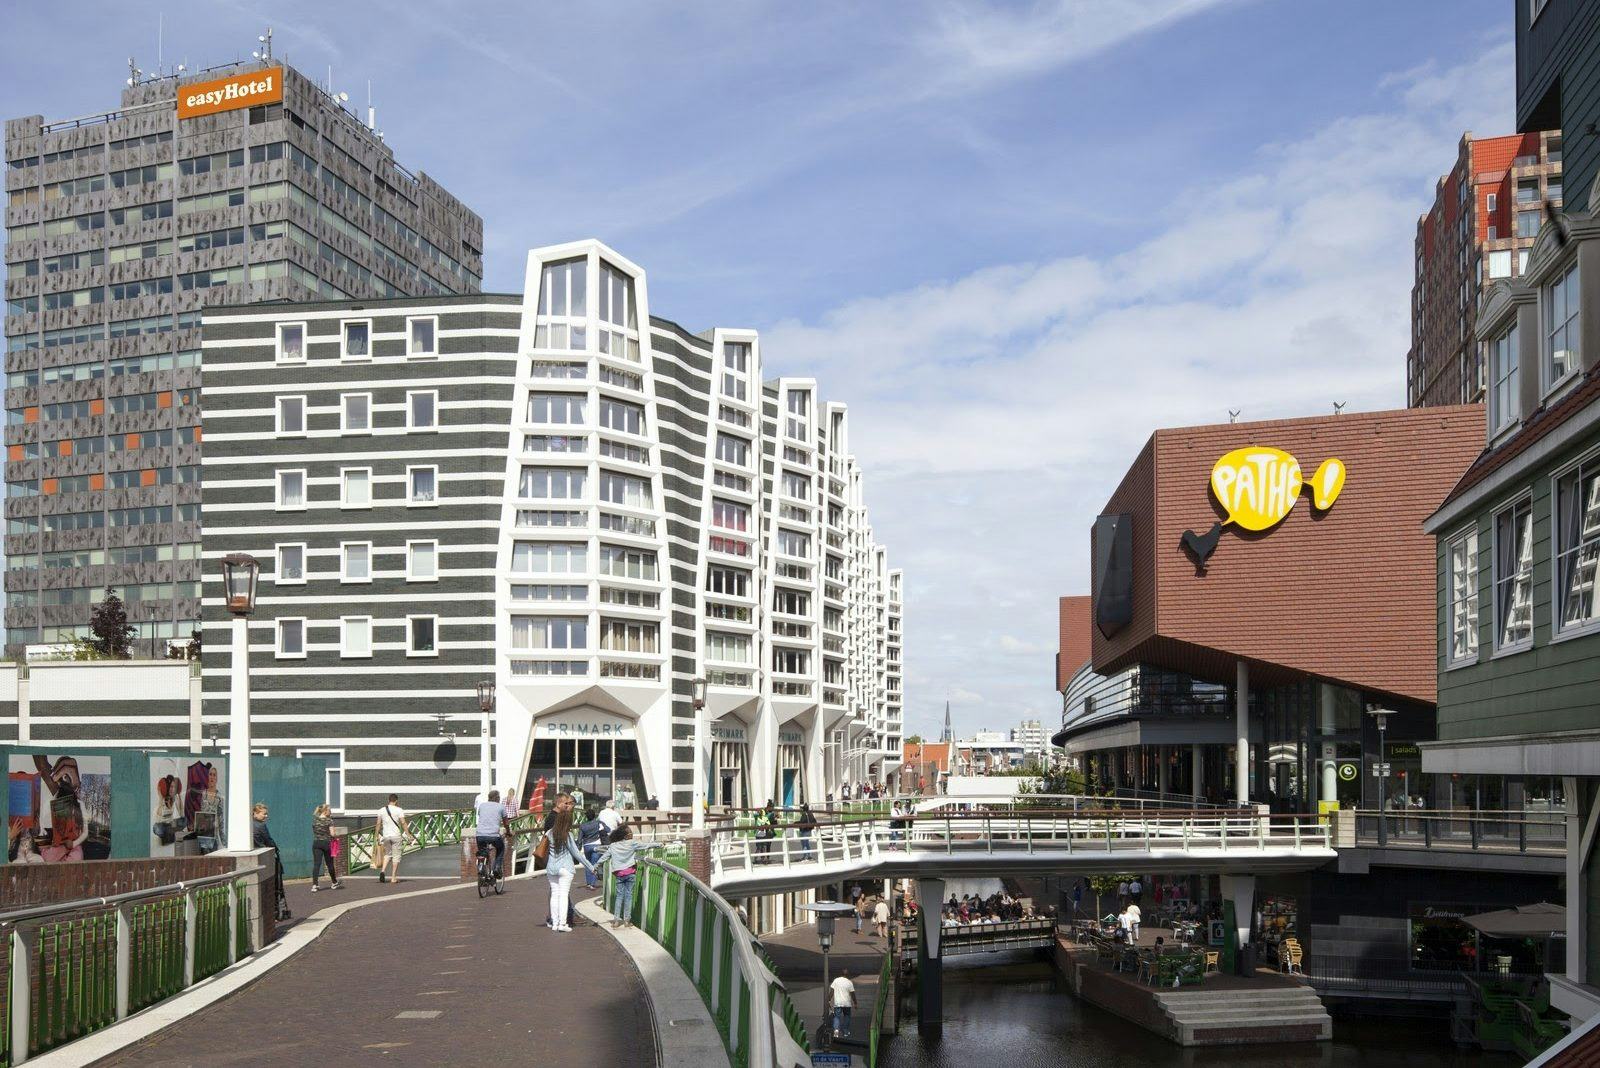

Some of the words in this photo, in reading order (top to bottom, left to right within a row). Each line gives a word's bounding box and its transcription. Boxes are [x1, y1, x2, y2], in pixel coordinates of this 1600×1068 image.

[186, 76, 273, 107] easyHotel
[547, 722, 623, 736] PRIMARK
[714, 728, 744, 739] PRIMARK
